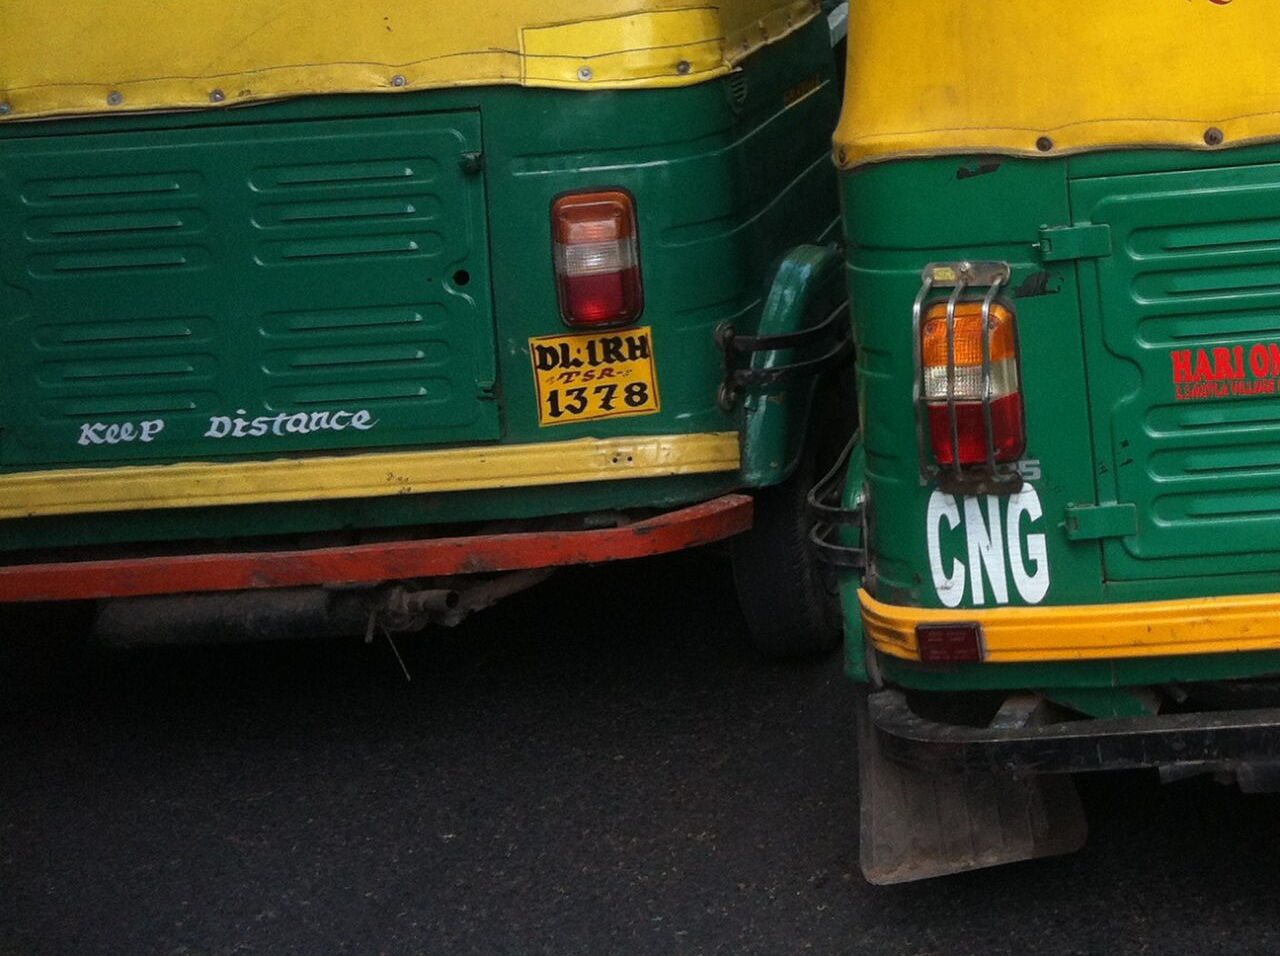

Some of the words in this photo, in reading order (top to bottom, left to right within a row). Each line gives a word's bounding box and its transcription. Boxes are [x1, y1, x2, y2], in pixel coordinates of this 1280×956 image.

[1170, 345, 1246, 384] HARI
[546, 381, 649, 418] 1378
[203, 407, 381, 439] Distance
[926, 482, 1050, 608] CNG
